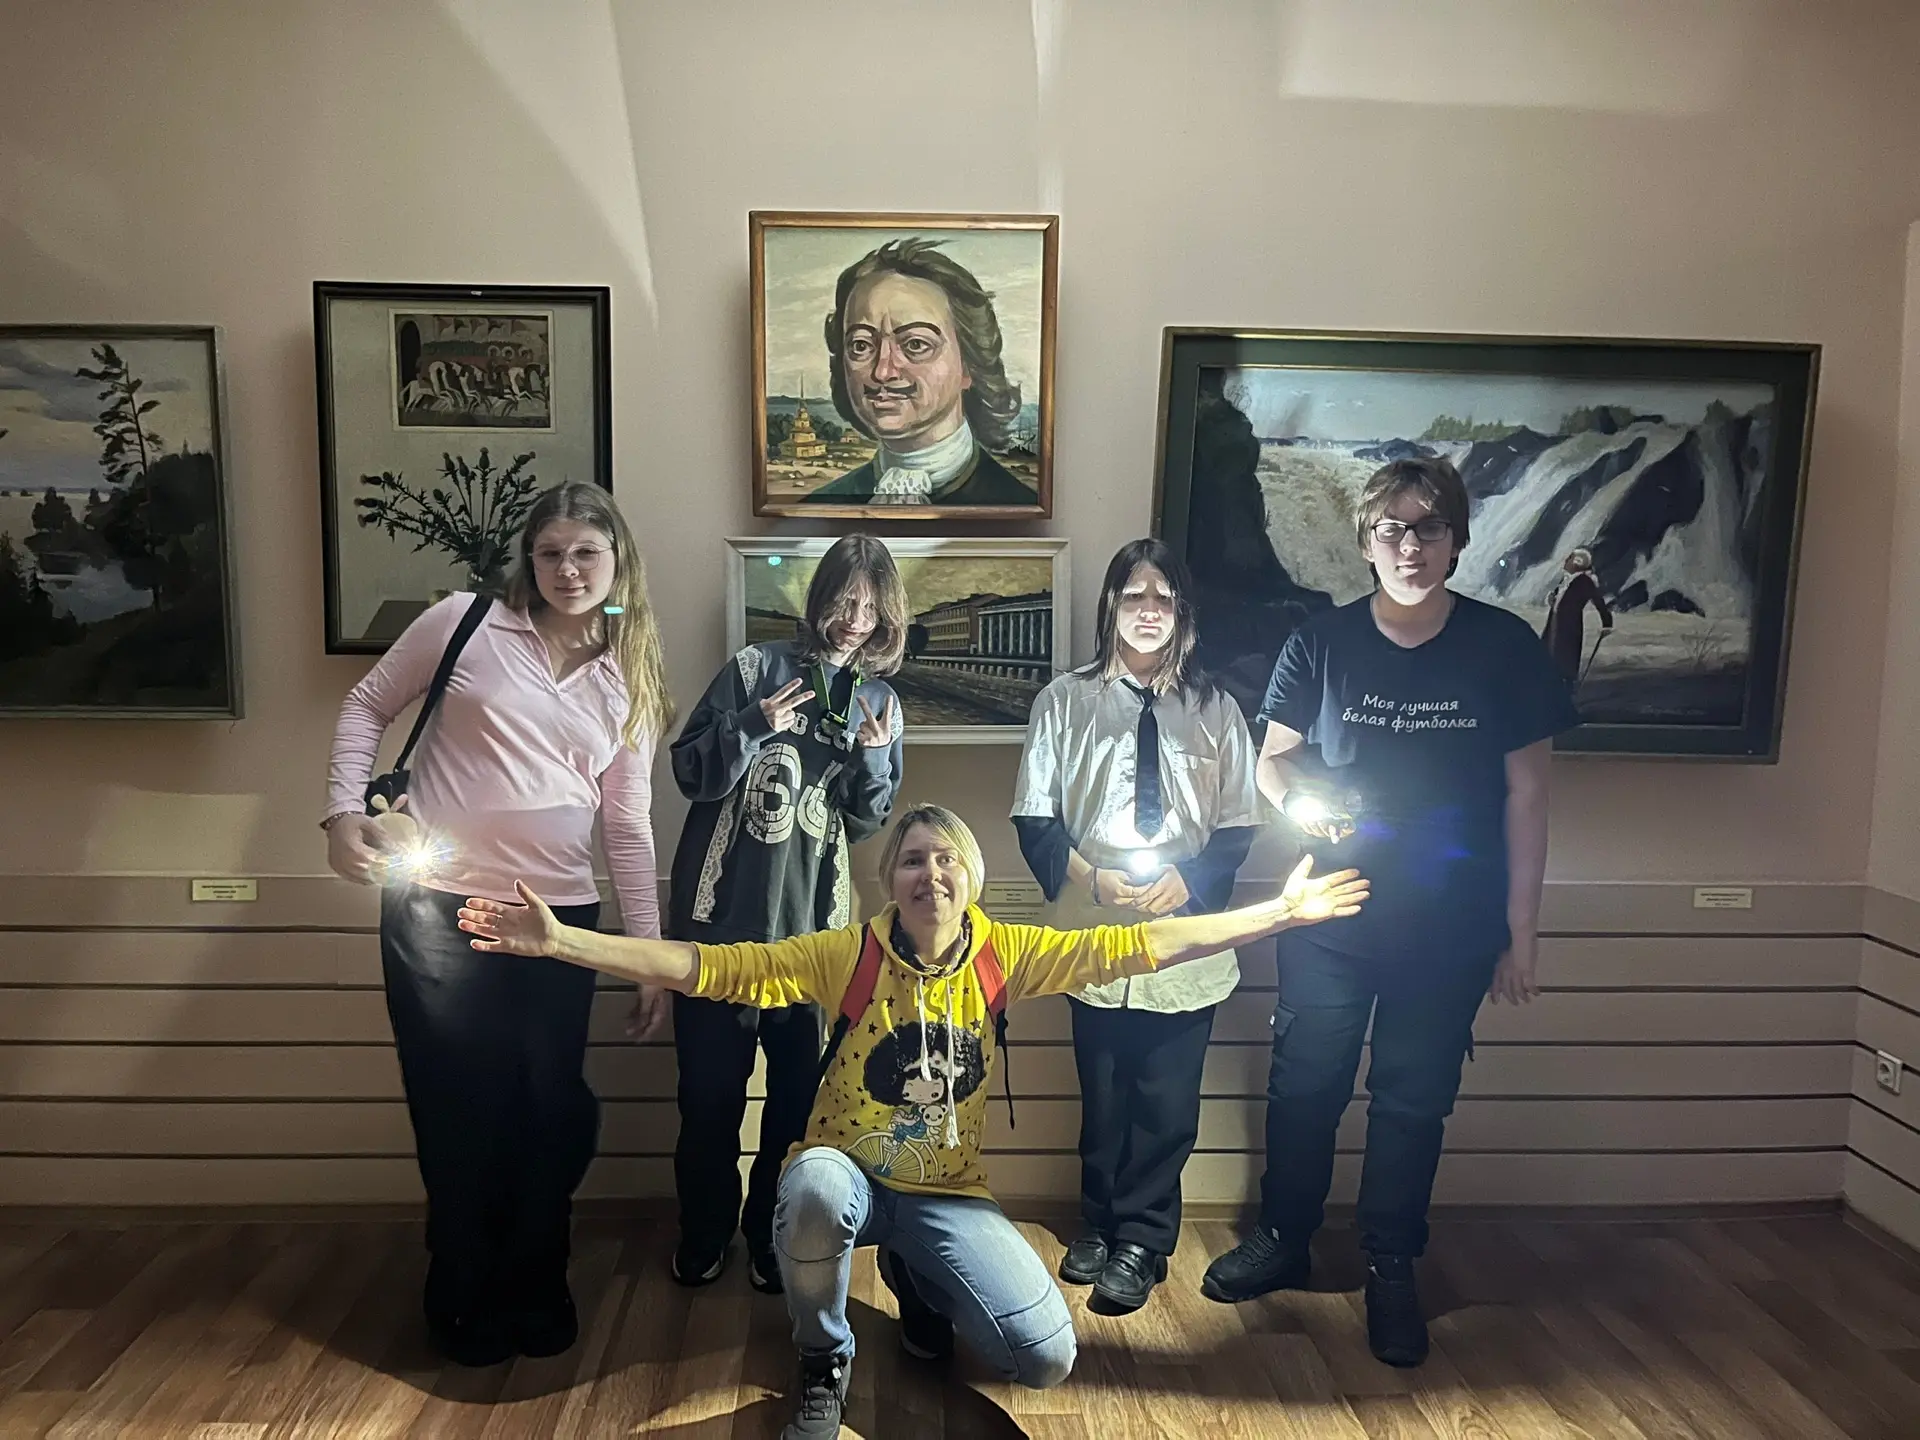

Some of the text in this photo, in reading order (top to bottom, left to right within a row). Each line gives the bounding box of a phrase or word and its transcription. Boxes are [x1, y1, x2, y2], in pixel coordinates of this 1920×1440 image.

[1362, 693, 1459, 716] Моя лучшая
[1342, 707, 1478, 733] белая футболка
